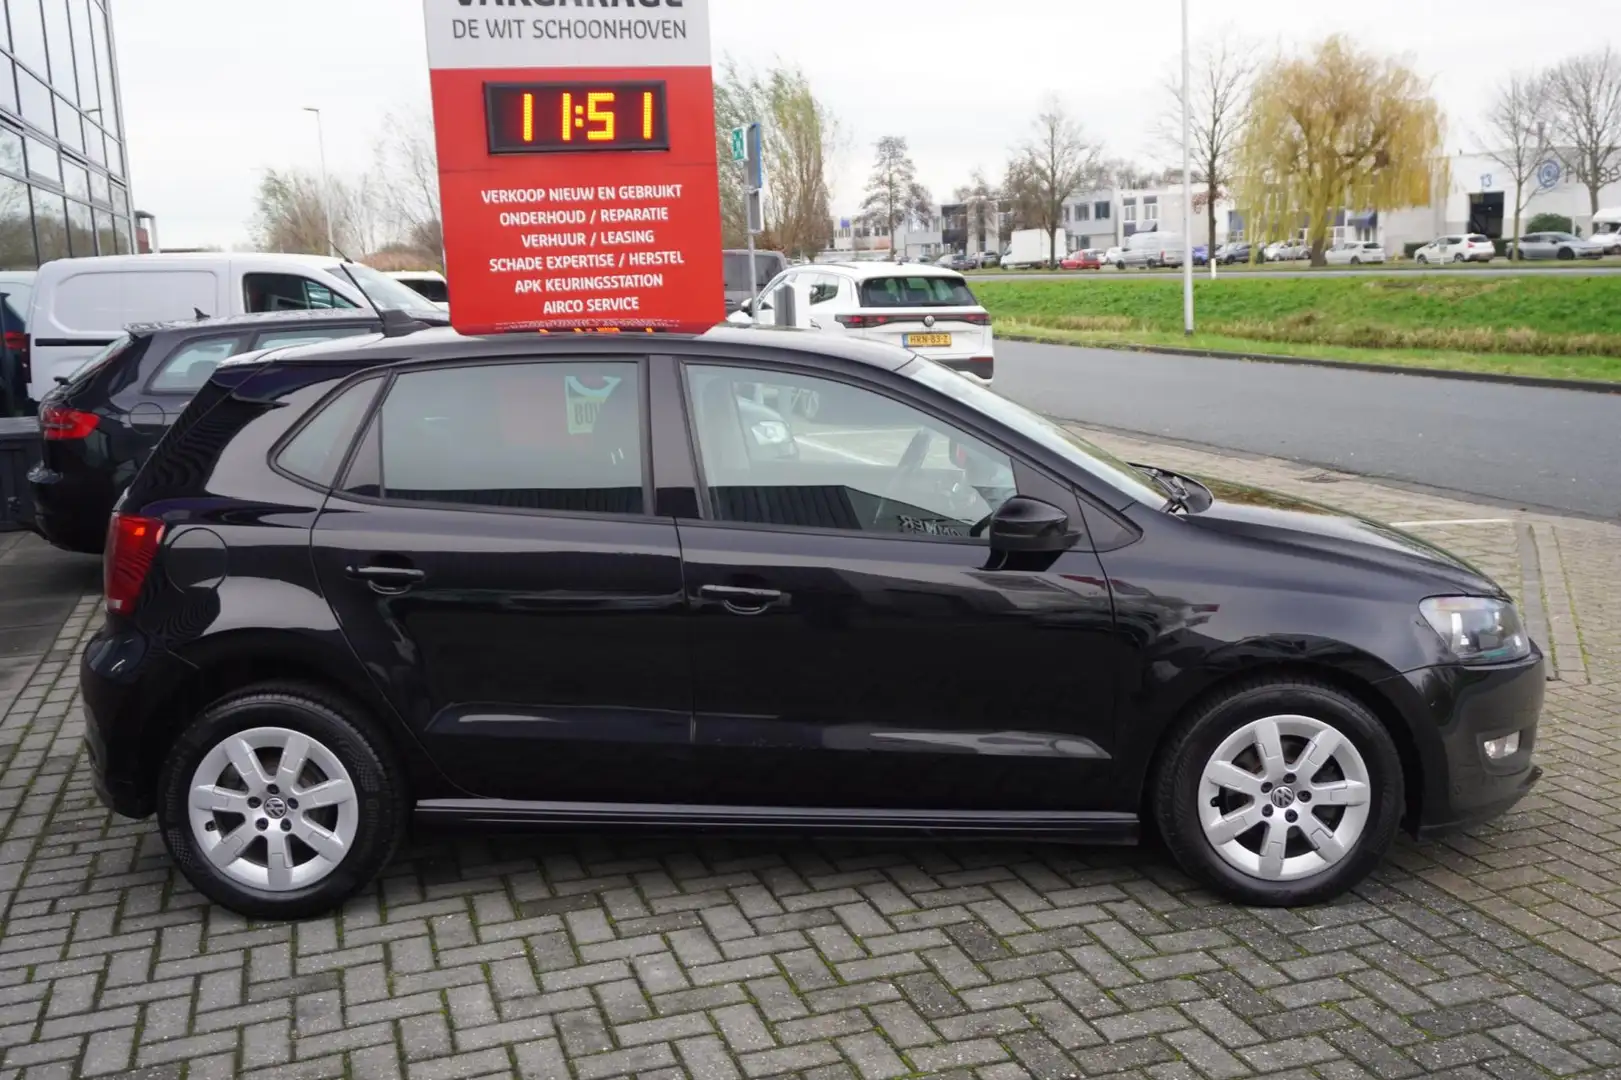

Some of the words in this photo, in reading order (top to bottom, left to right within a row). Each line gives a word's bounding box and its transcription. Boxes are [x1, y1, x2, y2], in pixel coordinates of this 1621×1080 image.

[453, 19, 479, 38] DE
[486, 19, 524, 38] WIT
[533, 20, 686, 39] SCHOONHOVEN
[522, 92, 652, 141] 11:51
[481, 189, 545, 203] VERKOOP
[549, 187, 594, 201] NIEUW
[598, 187, 615, 200] EN
[619, 184, 682, 199] GEBRUIKT
[500, 210, 586, 226] ONDERHOUD
[601, 207, 668, 222] REPARATIE
[521, 233, 586, 247] VERHUUR
[601, 230, 654, 244] LEASING
[490, 257, 543, 272] SCHADE
[546, 254, 614, 269] EXPERTISE
[629, 251, 684, 265] HERSTEL
[515, 279, 542, 293] APK
[546, 274, 663, 291] KEURINGSSTATION
[544, 300, 583, 313] AIRCO
[587, 297, 639, 312] SERVICE
